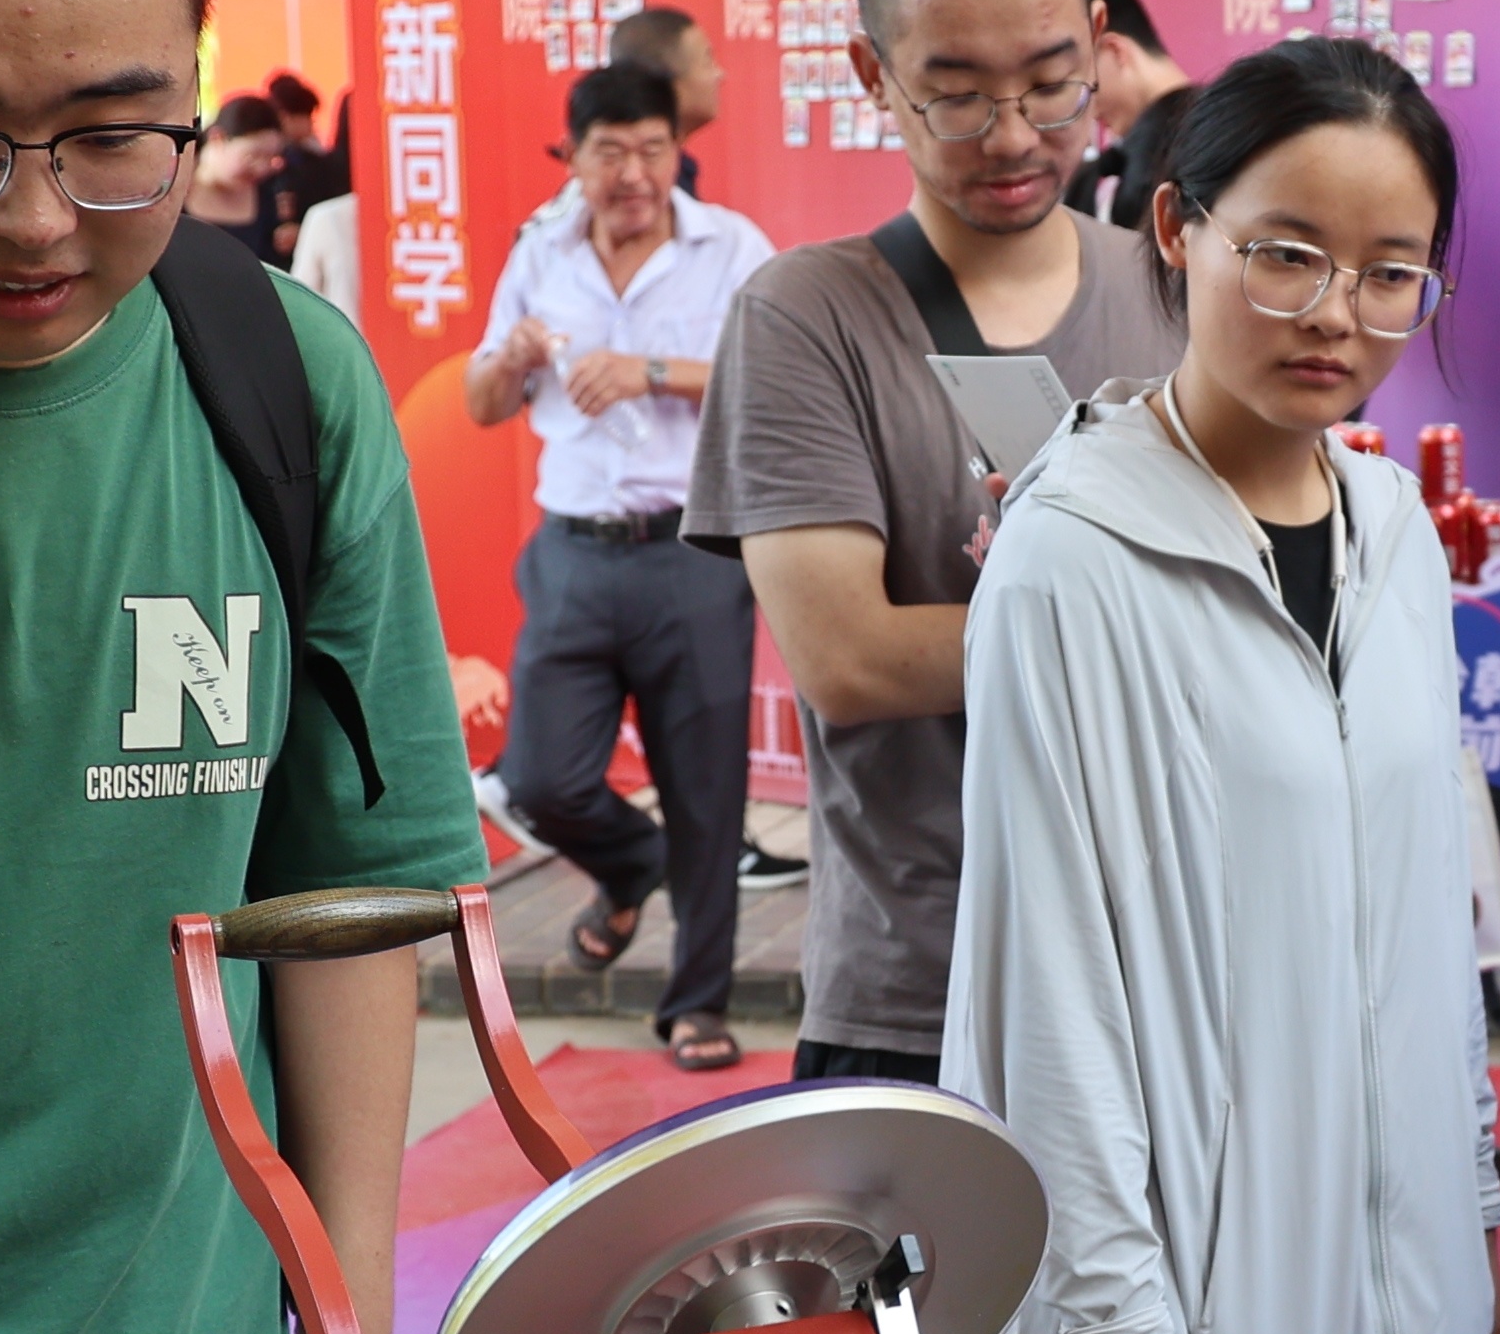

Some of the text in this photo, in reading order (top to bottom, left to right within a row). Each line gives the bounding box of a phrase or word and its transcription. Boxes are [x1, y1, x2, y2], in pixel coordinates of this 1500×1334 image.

[120, 593, 261, 752] N
[172, 632, 233, 726] Keep on
[85, 762, 190, 801] CROSSING
[192, 756, 249, 795] FINISH
